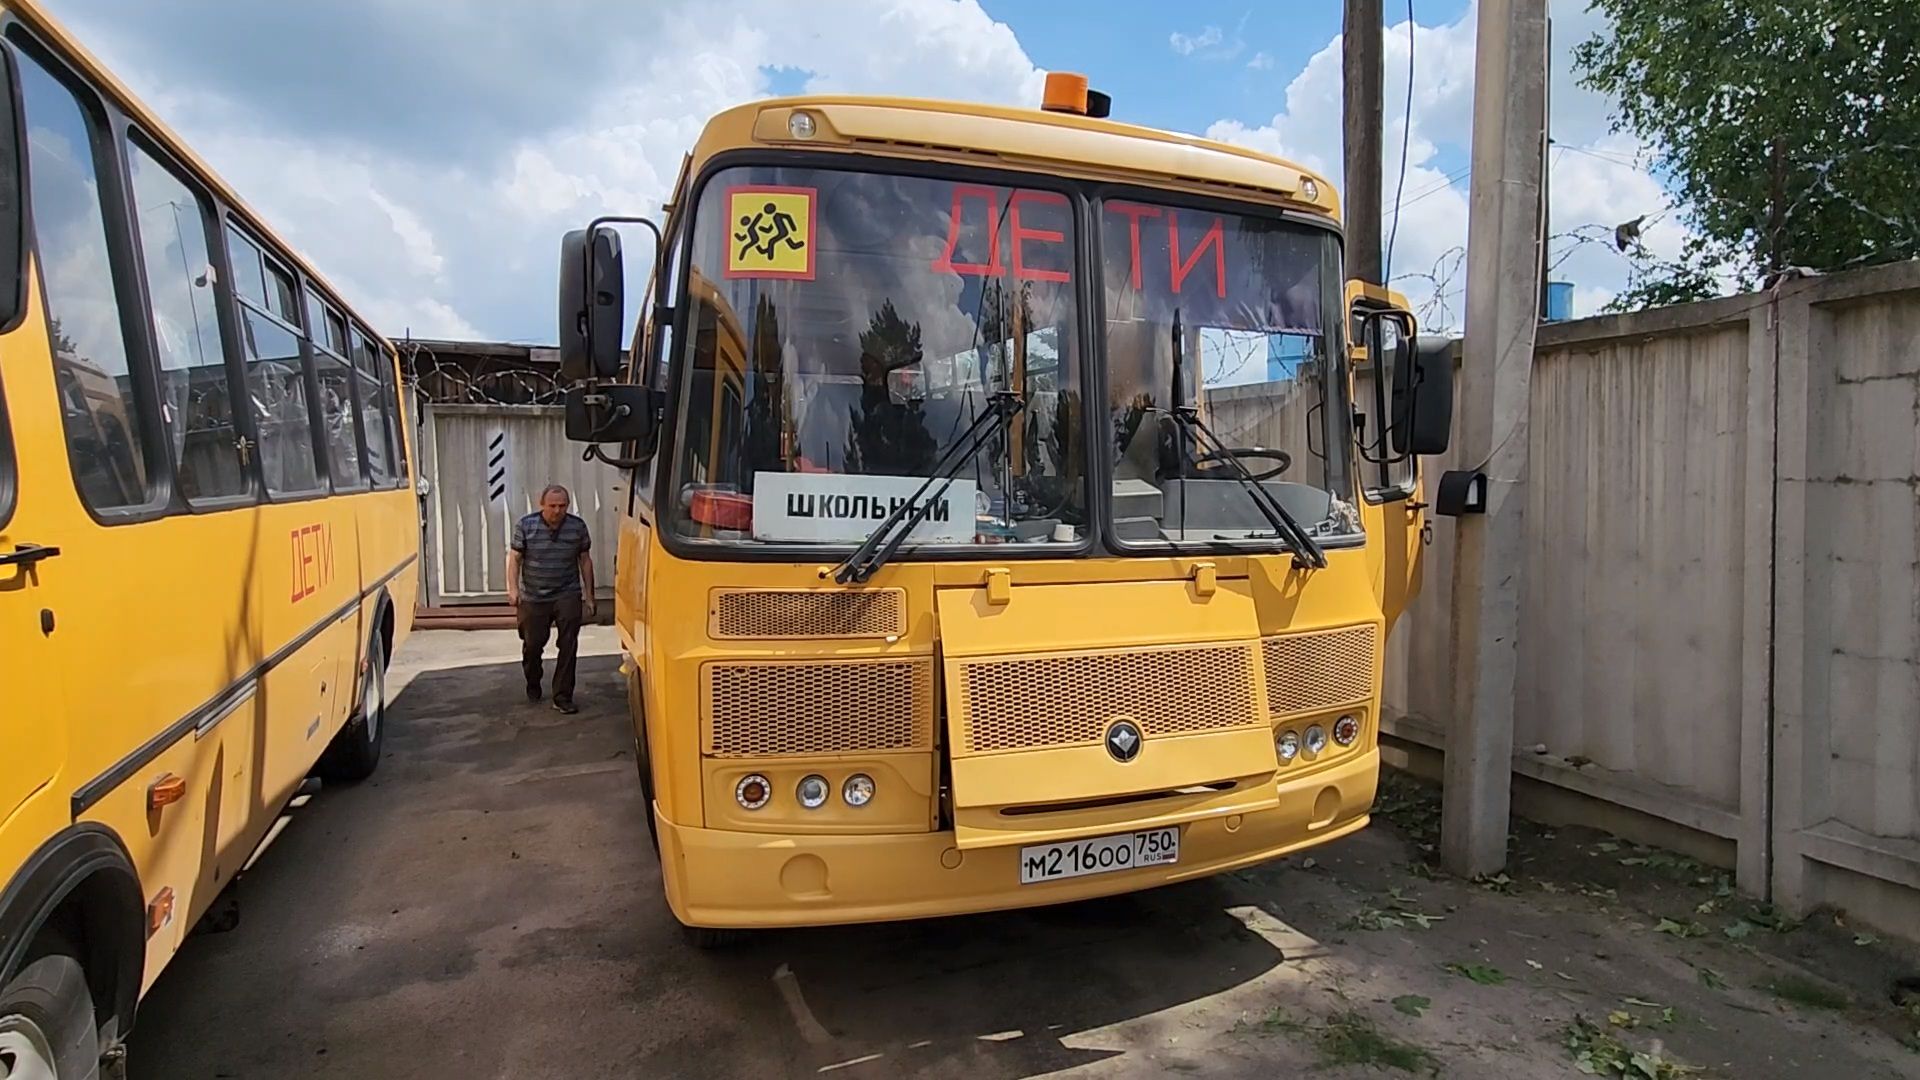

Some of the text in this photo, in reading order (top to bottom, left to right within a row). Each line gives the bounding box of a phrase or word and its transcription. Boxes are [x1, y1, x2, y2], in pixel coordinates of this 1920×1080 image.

[290, 521, 335, 604] ДЕТИ
[1136, 831, 1172, 855] 750
[1143, 853, 1162, 863] RUS
